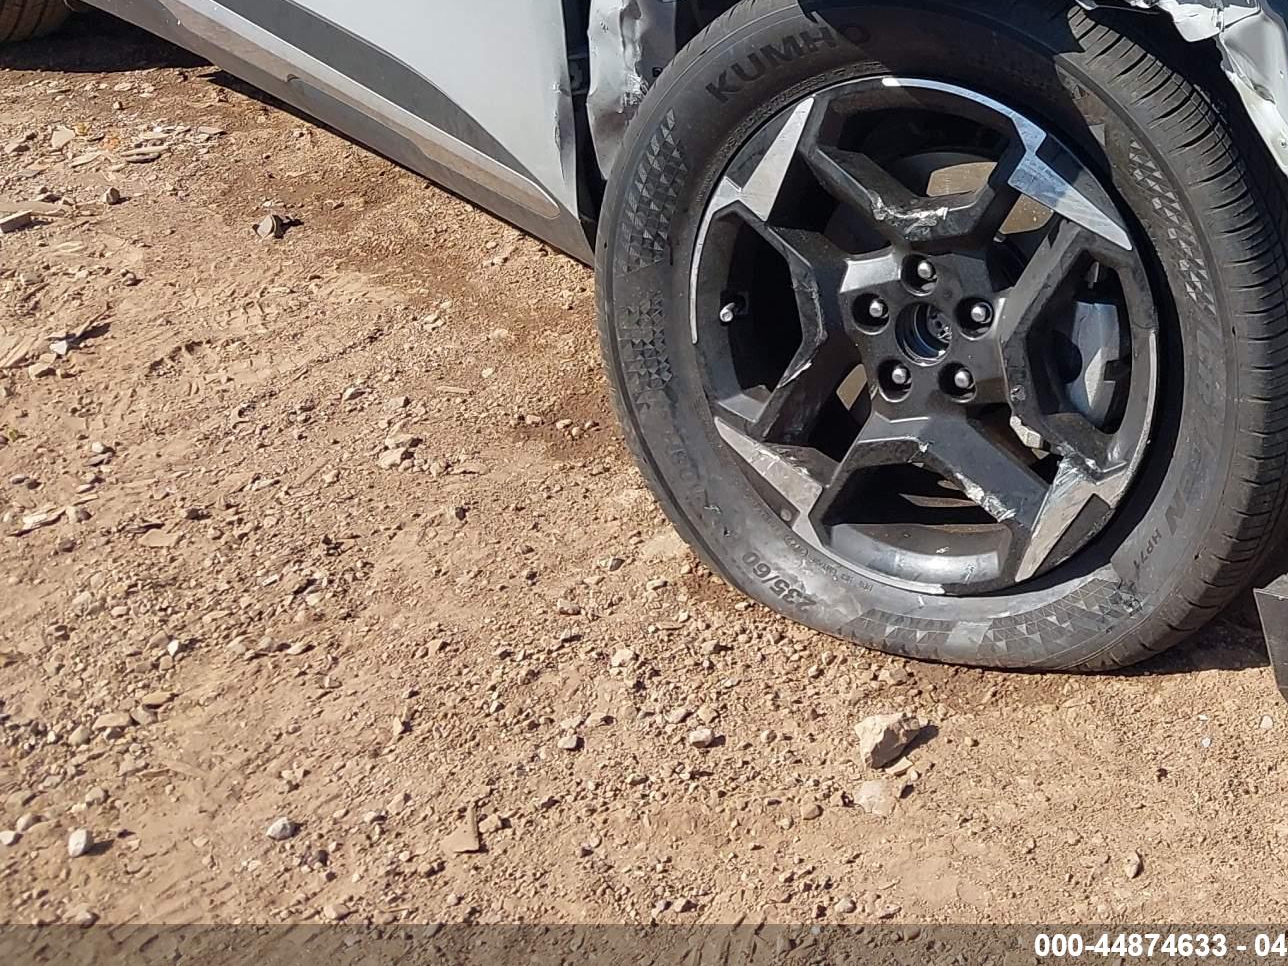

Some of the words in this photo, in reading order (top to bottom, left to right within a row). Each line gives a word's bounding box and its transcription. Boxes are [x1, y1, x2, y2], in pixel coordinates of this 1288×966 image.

[705, 21, 871, 105] KUMHO
[1133, 527, 1163, 572] HP71
[742, 551, 818, 612] 235/60
